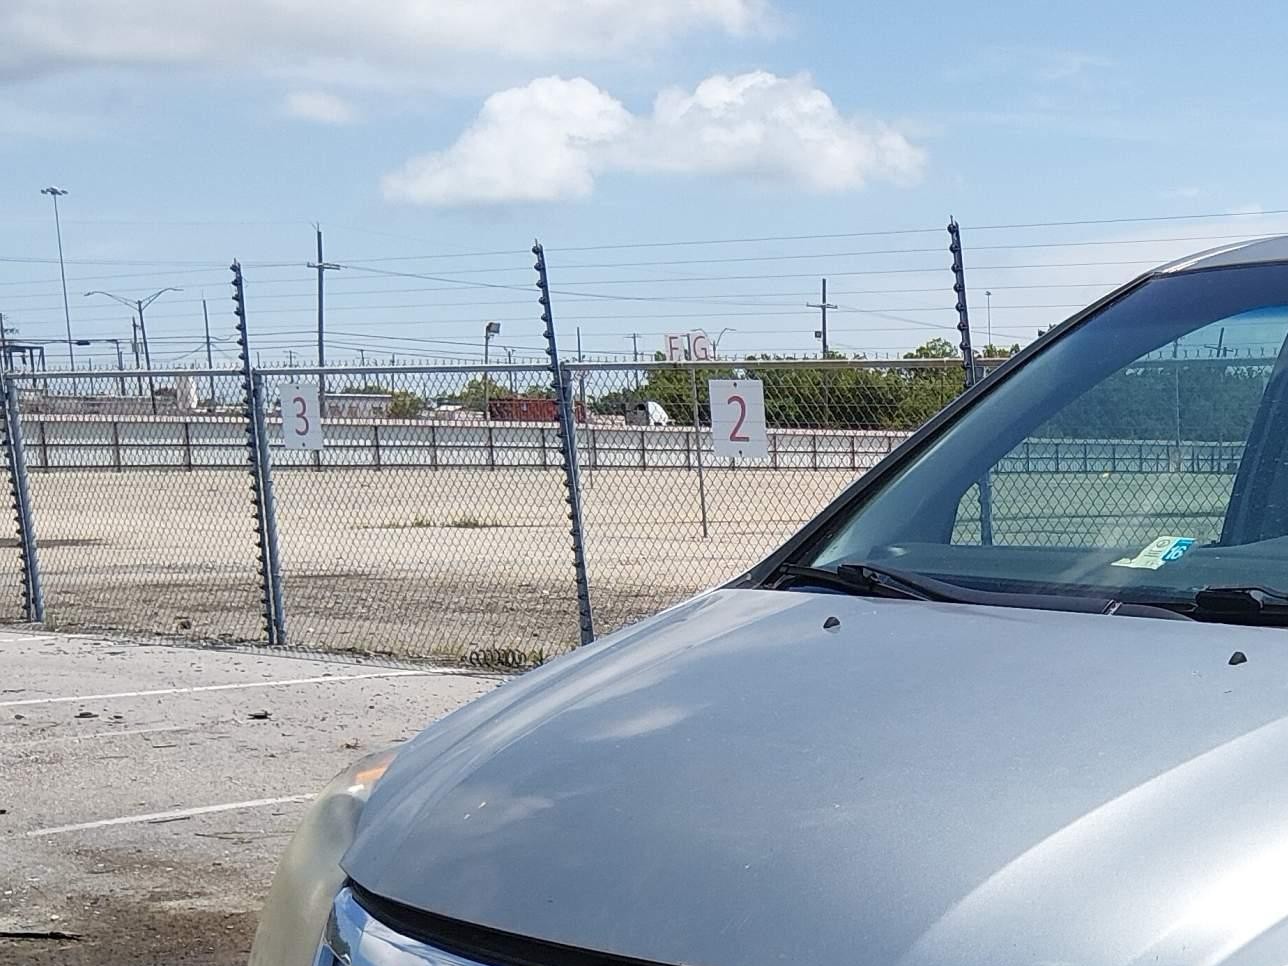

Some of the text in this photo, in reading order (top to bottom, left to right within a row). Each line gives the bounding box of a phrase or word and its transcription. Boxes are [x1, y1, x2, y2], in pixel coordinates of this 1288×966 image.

[292, 396, 310, 436] 3
[727, 395, 750, 442] 2
[1165, 545, 1187, 560] 16
